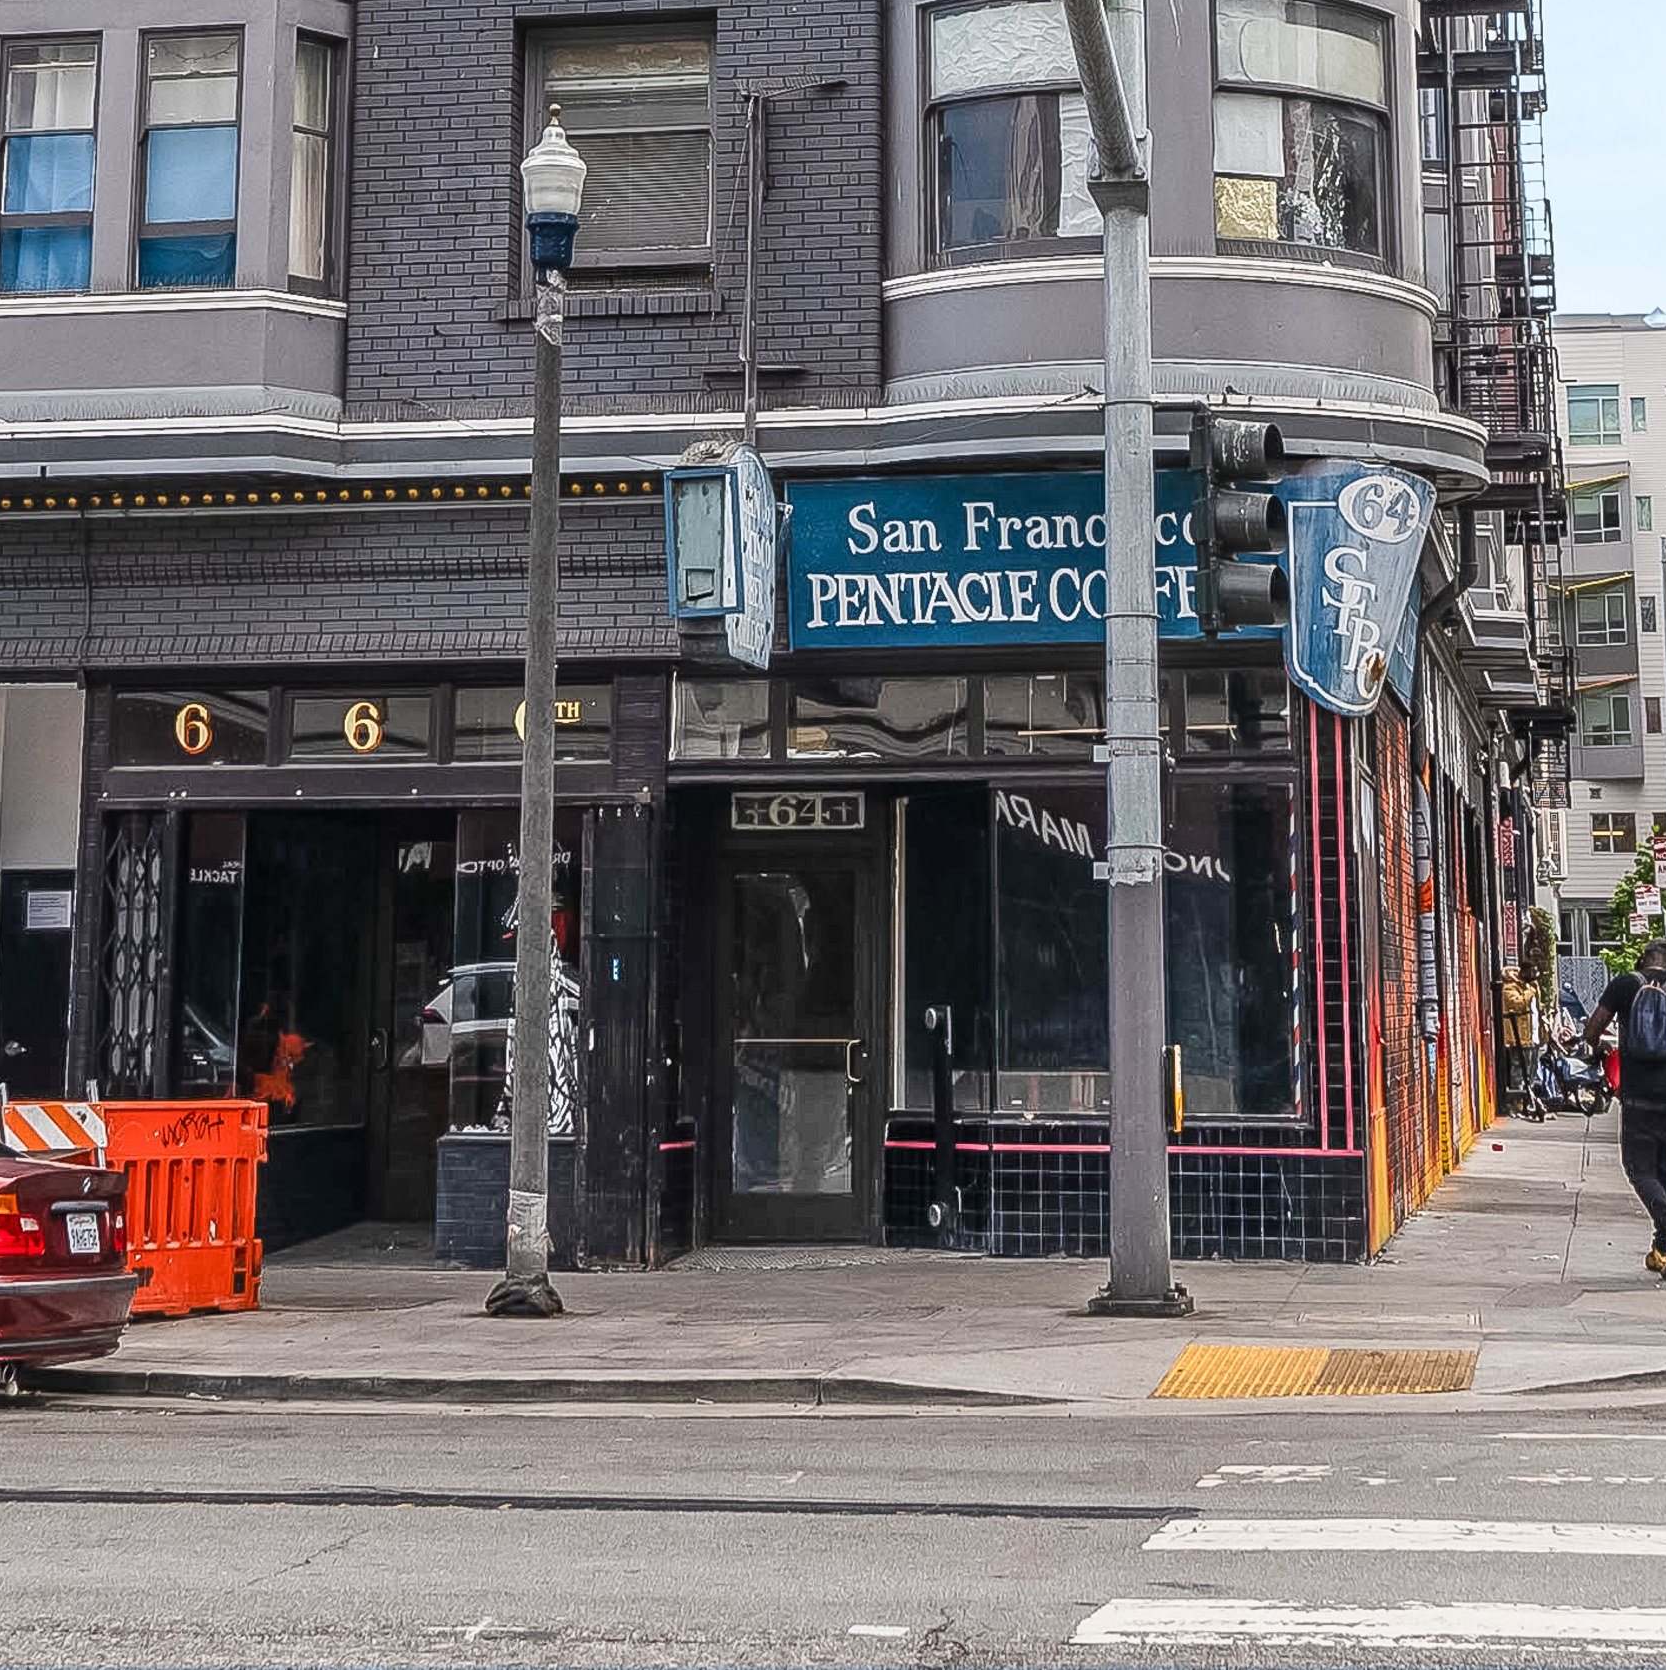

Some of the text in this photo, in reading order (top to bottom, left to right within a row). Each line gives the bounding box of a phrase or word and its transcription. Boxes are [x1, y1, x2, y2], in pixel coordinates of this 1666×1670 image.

[847, 501, 942, 555] San
[1351, 483, 1414, 536] 64
[175, 703, 212, 755] 6
[344, 702, 383, 754] 6
[769, 792, 830, 826] 64
